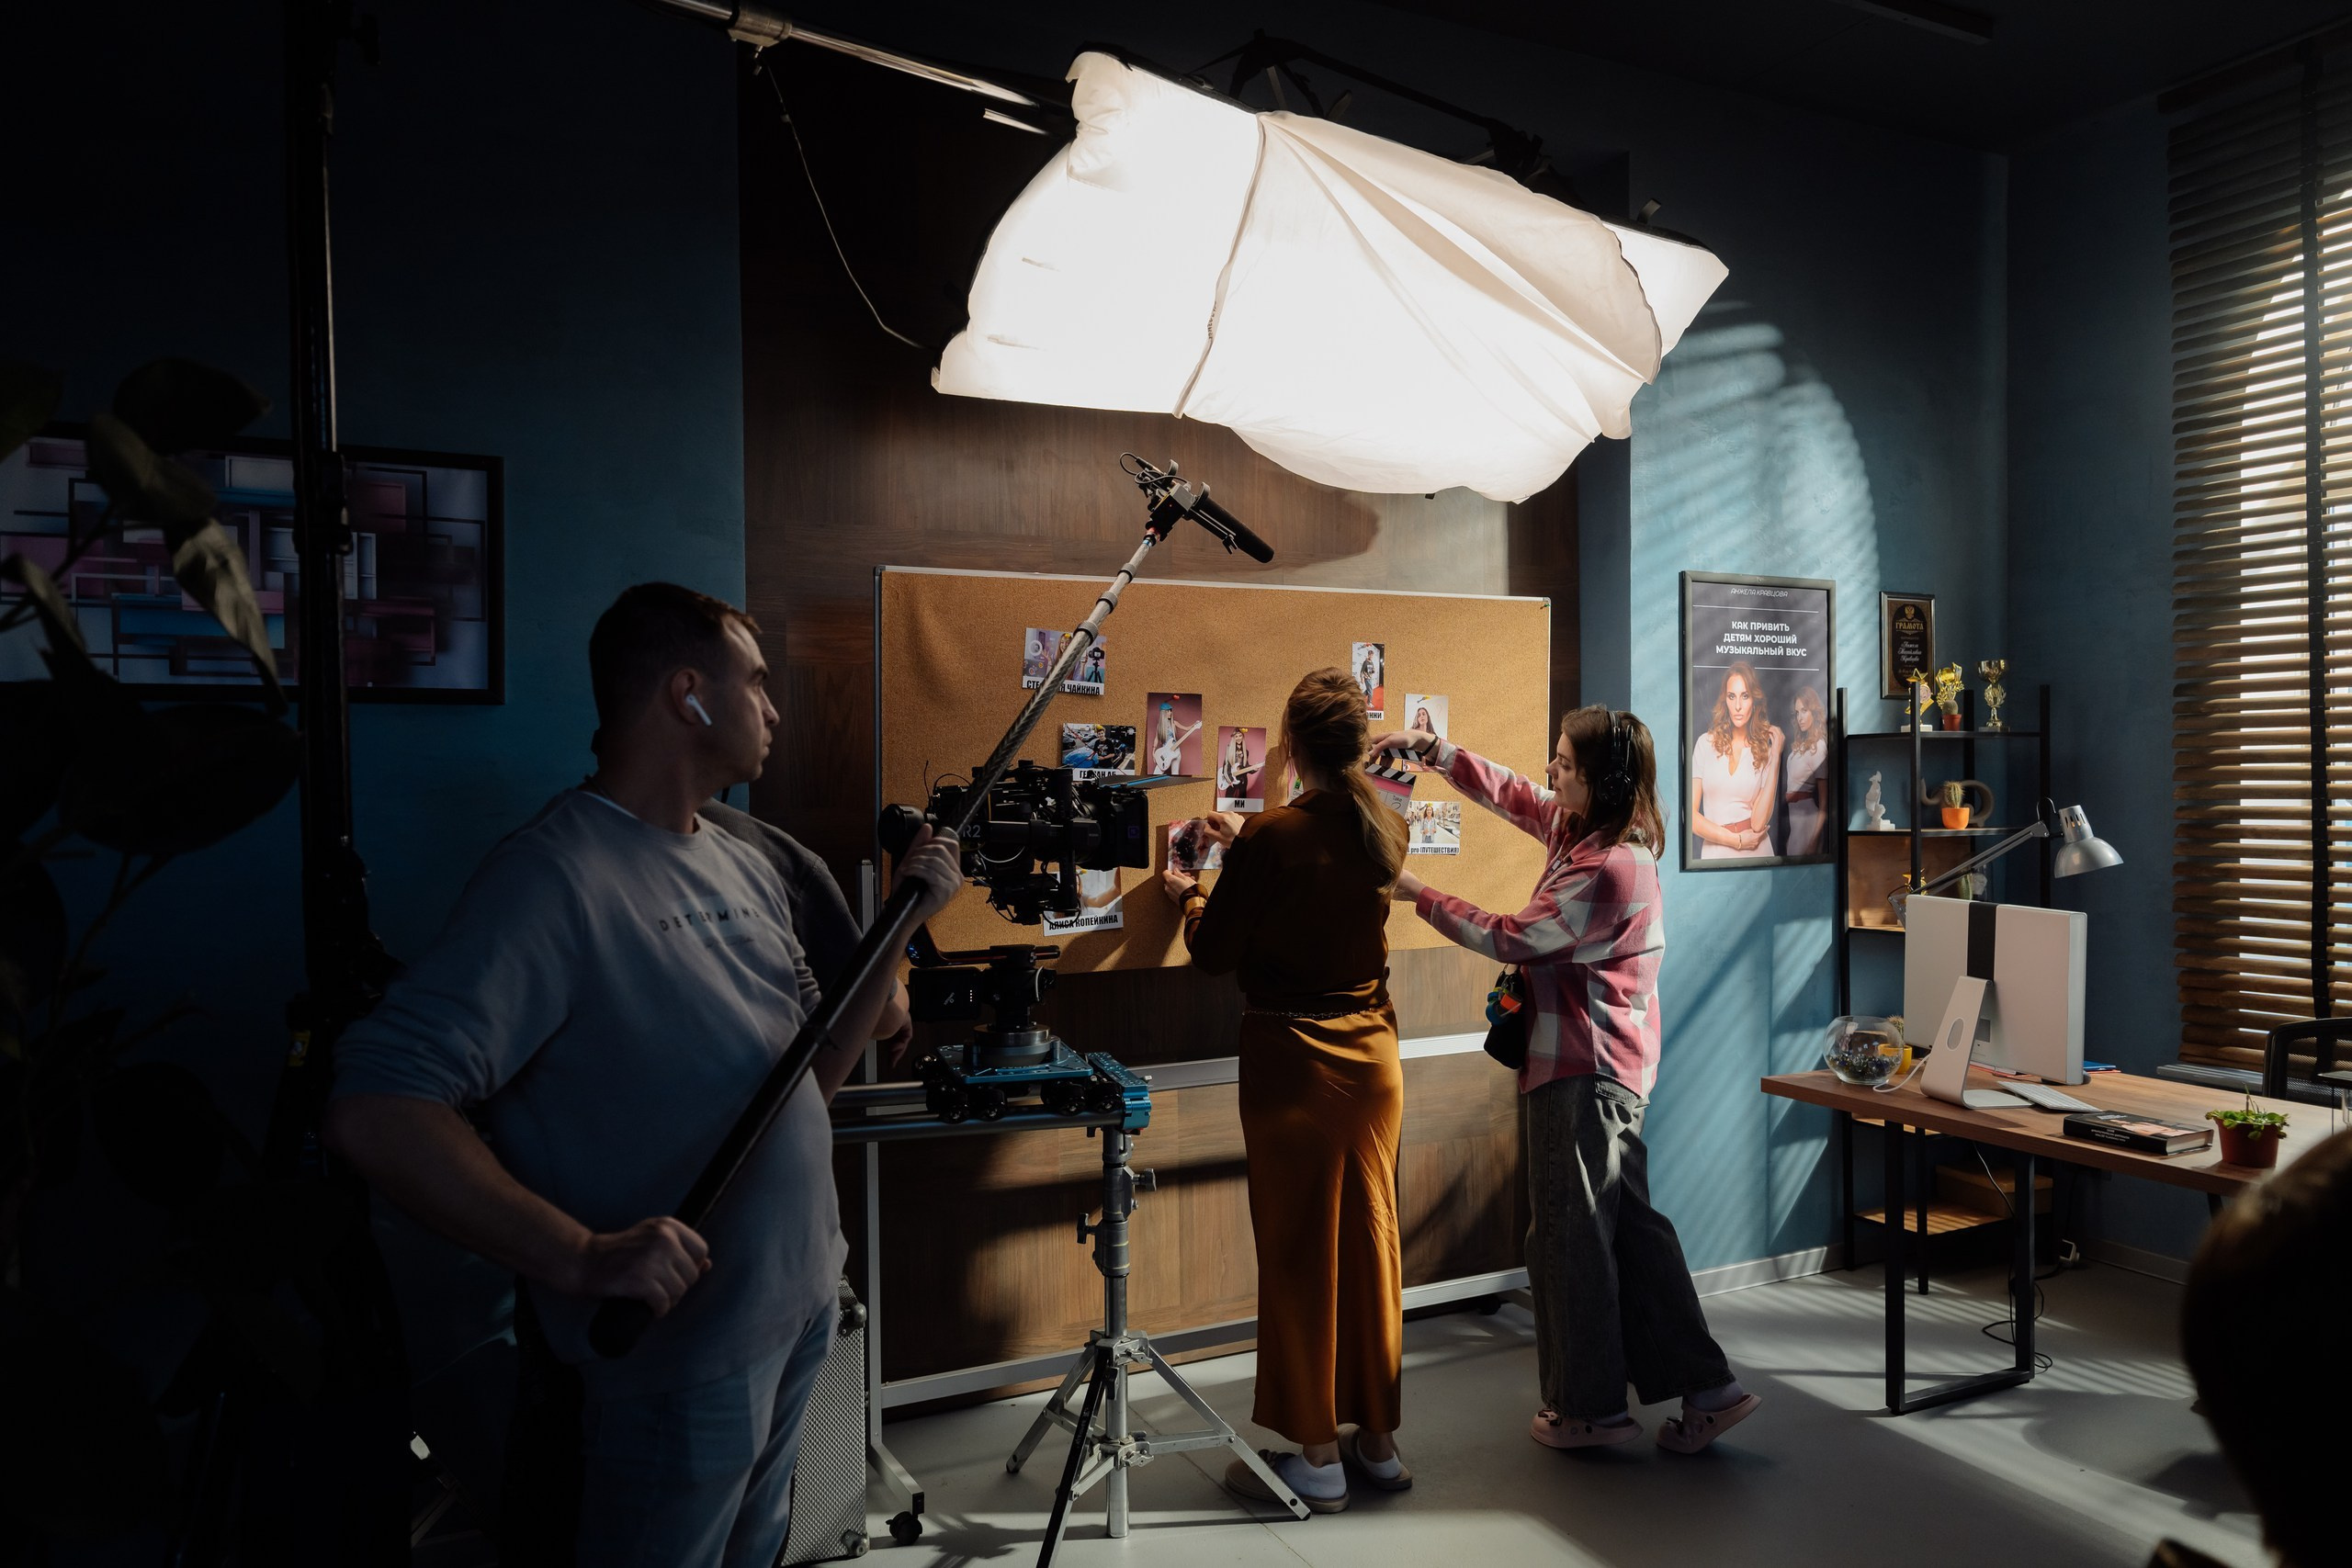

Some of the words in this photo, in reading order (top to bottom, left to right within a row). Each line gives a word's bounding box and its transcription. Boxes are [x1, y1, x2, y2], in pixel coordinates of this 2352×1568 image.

[1756, 589, 1788, 597] КРАВЦОВА
[1732, 621, 1748, 630] КАК
[1750, 622, 1790, 631] ПРИВИТЬ
[1895, 622, 1924, 630] ГРАМОТА
[1723, 634, 1752, 643] ДЕТЯМ
[1754, 634, 1797, 644] ХОРОШИЙ
[1715, 645, 1783, 656] МУЗЫКАЛЬНЫЙ
[1786, 649, 1807, 657] ВКУС
[1067, 683, 1100, 695] ЧАЙКИНА
[1075, 914, 1118, 928] КОПЕЙКИНА
